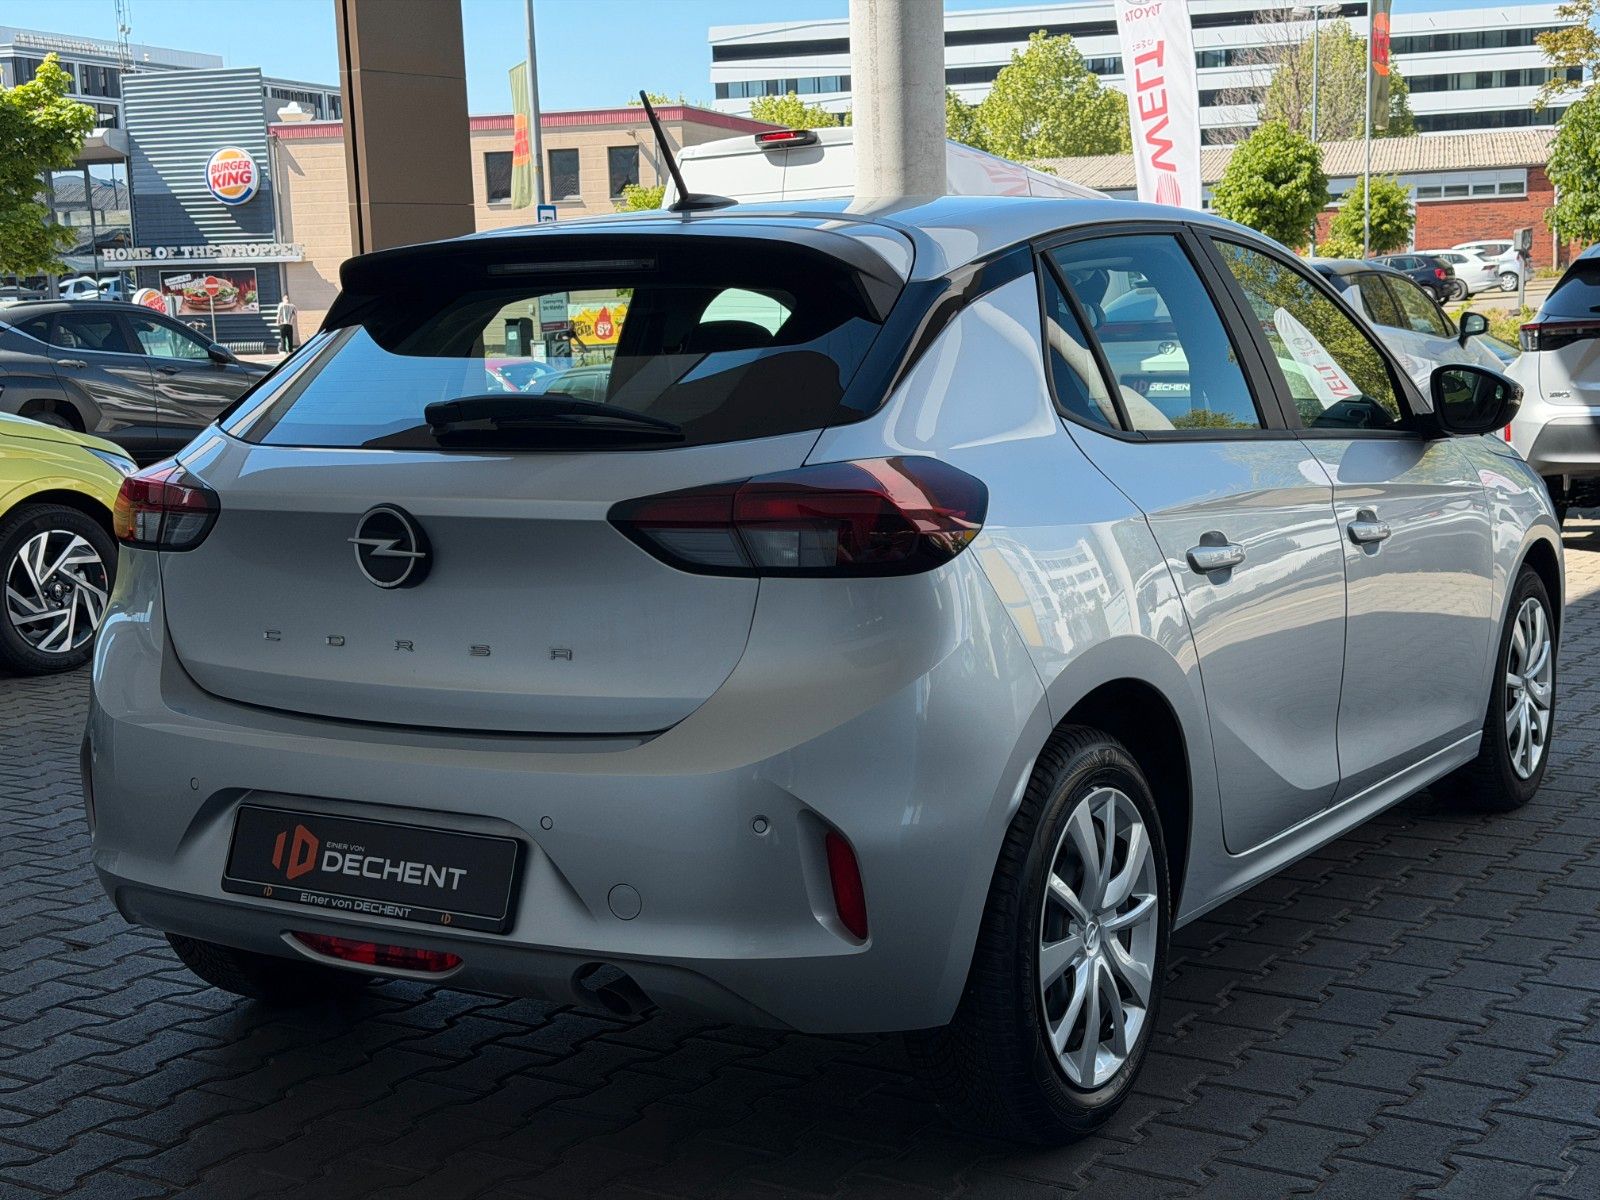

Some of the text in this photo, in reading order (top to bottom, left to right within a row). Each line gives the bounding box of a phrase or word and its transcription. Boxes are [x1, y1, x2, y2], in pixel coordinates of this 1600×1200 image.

[211, 160, 251, 175] BURGER
[212, 170, 252, 190] KING
[102, 243, 304, 261] HOME OF THE WHOPPER
[1149, 382, 1190, 391] DECHEN
[263, 629, 573, 662] CORSA
[326, 840, 366, 853] EINER VON
[321, 850, 468, 890] DECHENT
[300, 892, 412, 918] Einer von DECHENT
